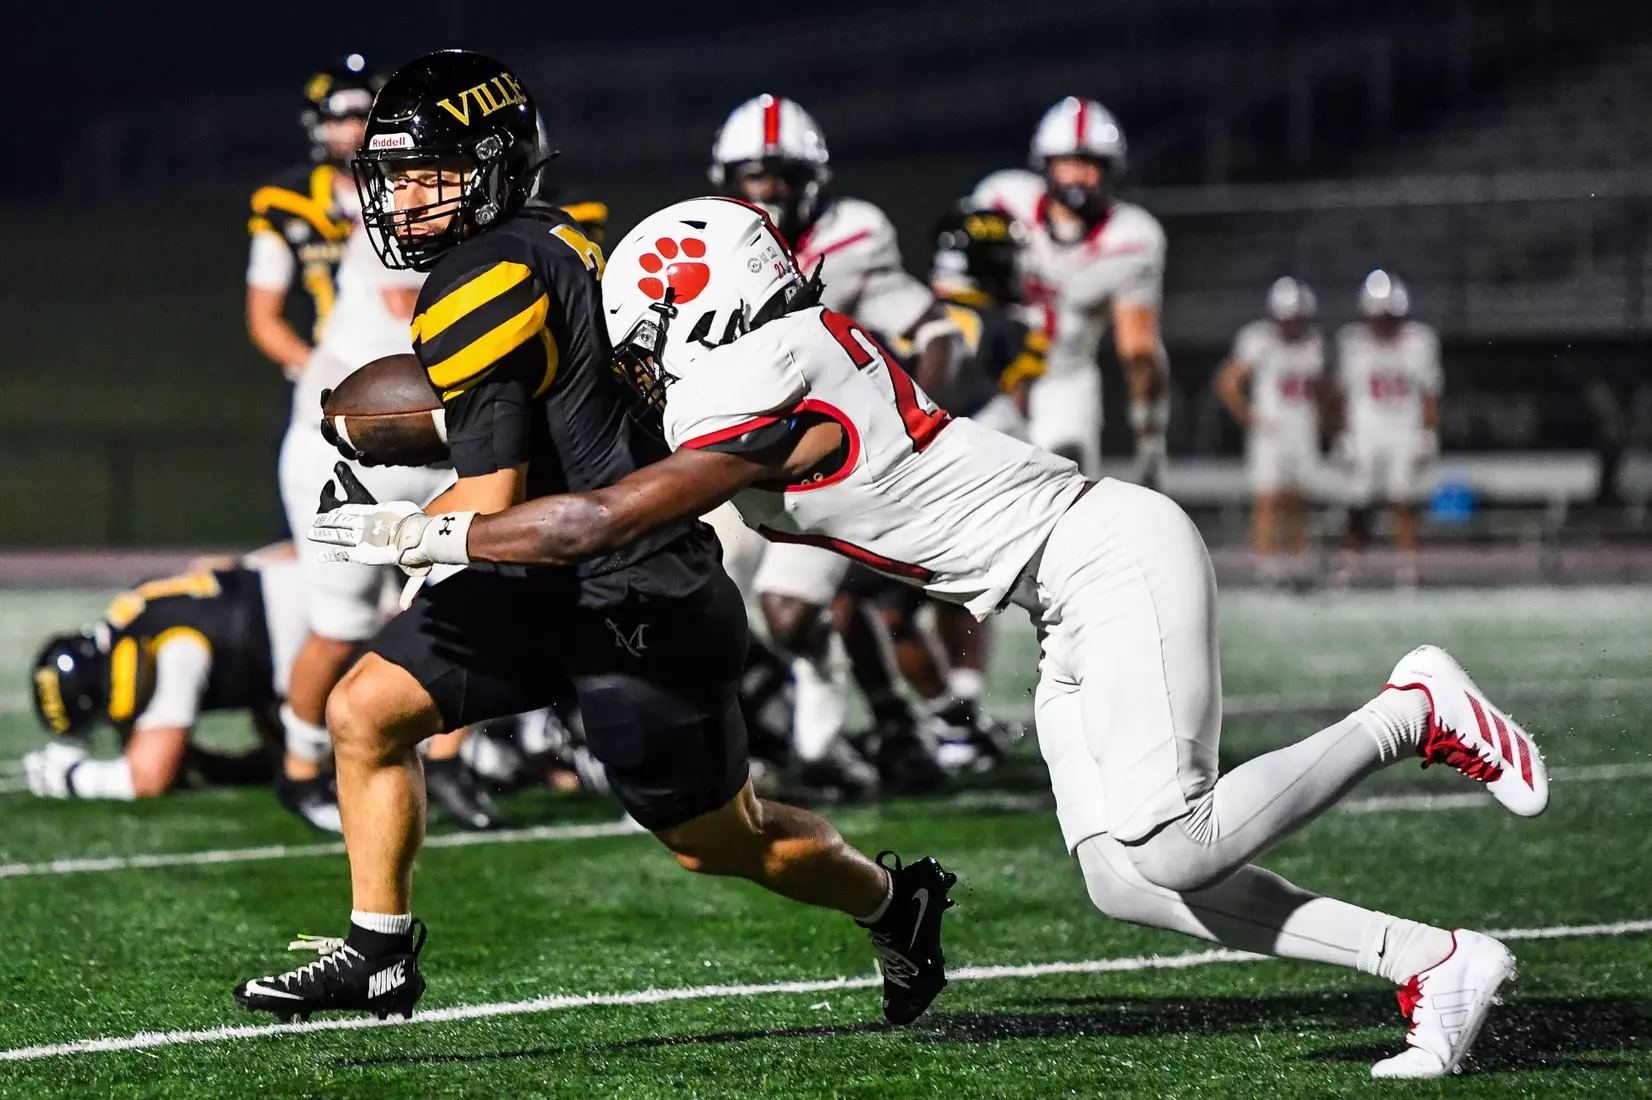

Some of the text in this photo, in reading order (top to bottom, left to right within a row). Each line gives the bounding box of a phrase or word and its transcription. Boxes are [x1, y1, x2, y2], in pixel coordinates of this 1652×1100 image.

[437, 73, 527, 126] VILLE
[372, 136, 406, 148] Riddell
[605, 618, 650, 657] M
[368, 959, 406, 999] NIKE
